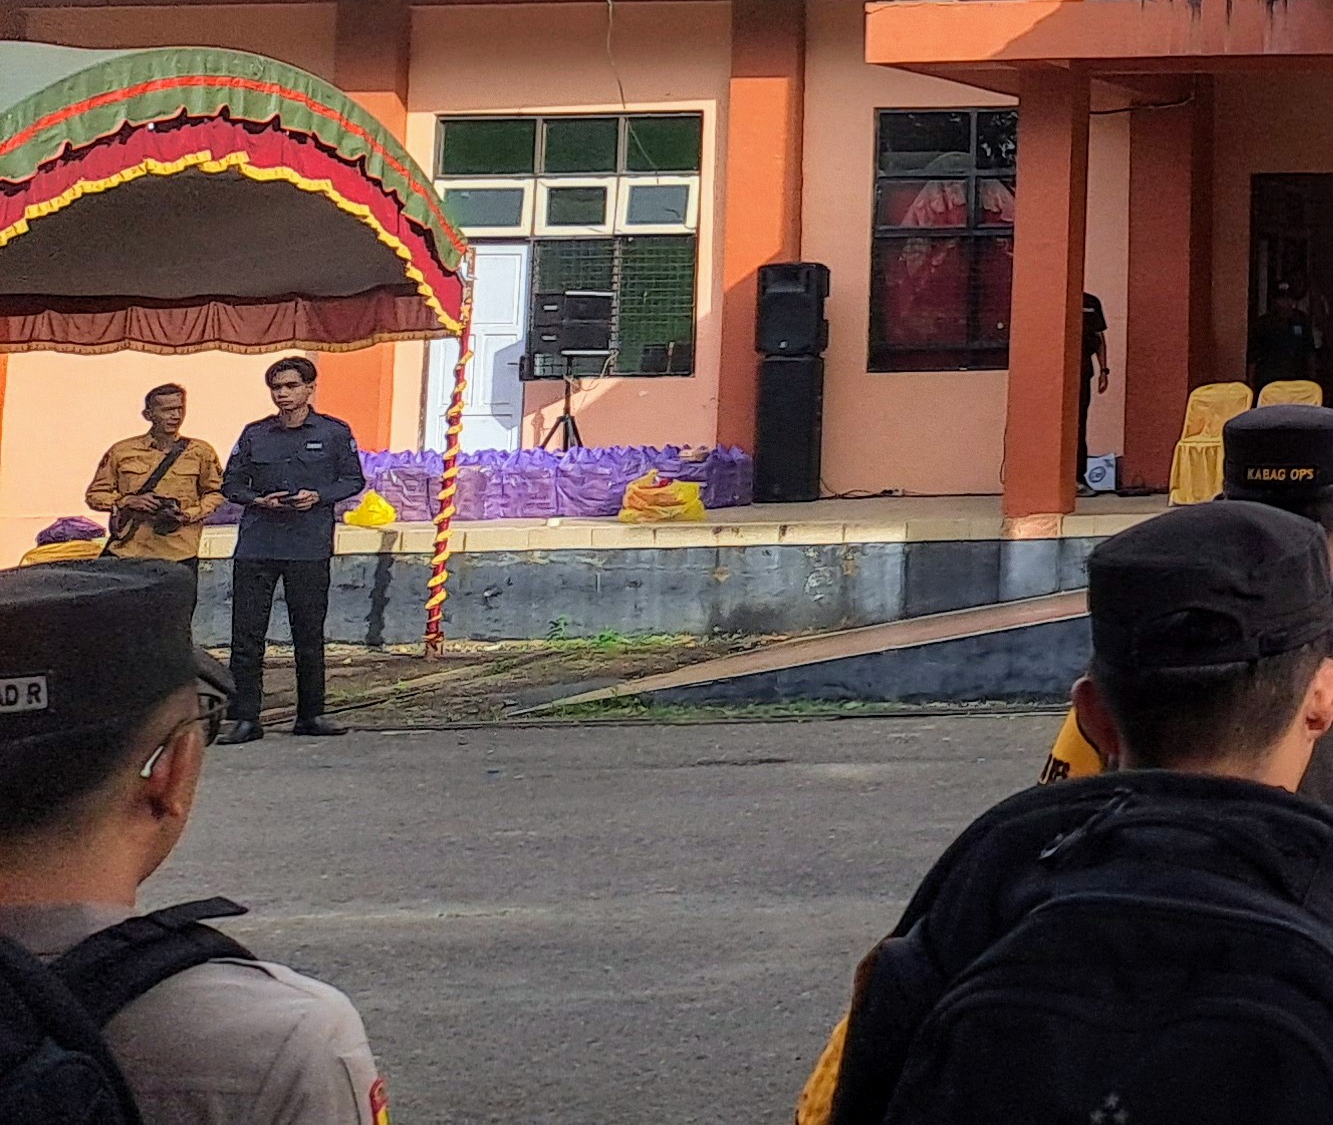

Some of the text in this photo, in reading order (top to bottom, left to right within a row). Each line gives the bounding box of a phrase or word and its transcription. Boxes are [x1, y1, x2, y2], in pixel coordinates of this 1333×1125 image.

[1247, 468, 1315, 481] KABAG OPS
[0, 683, 19, 707] D
